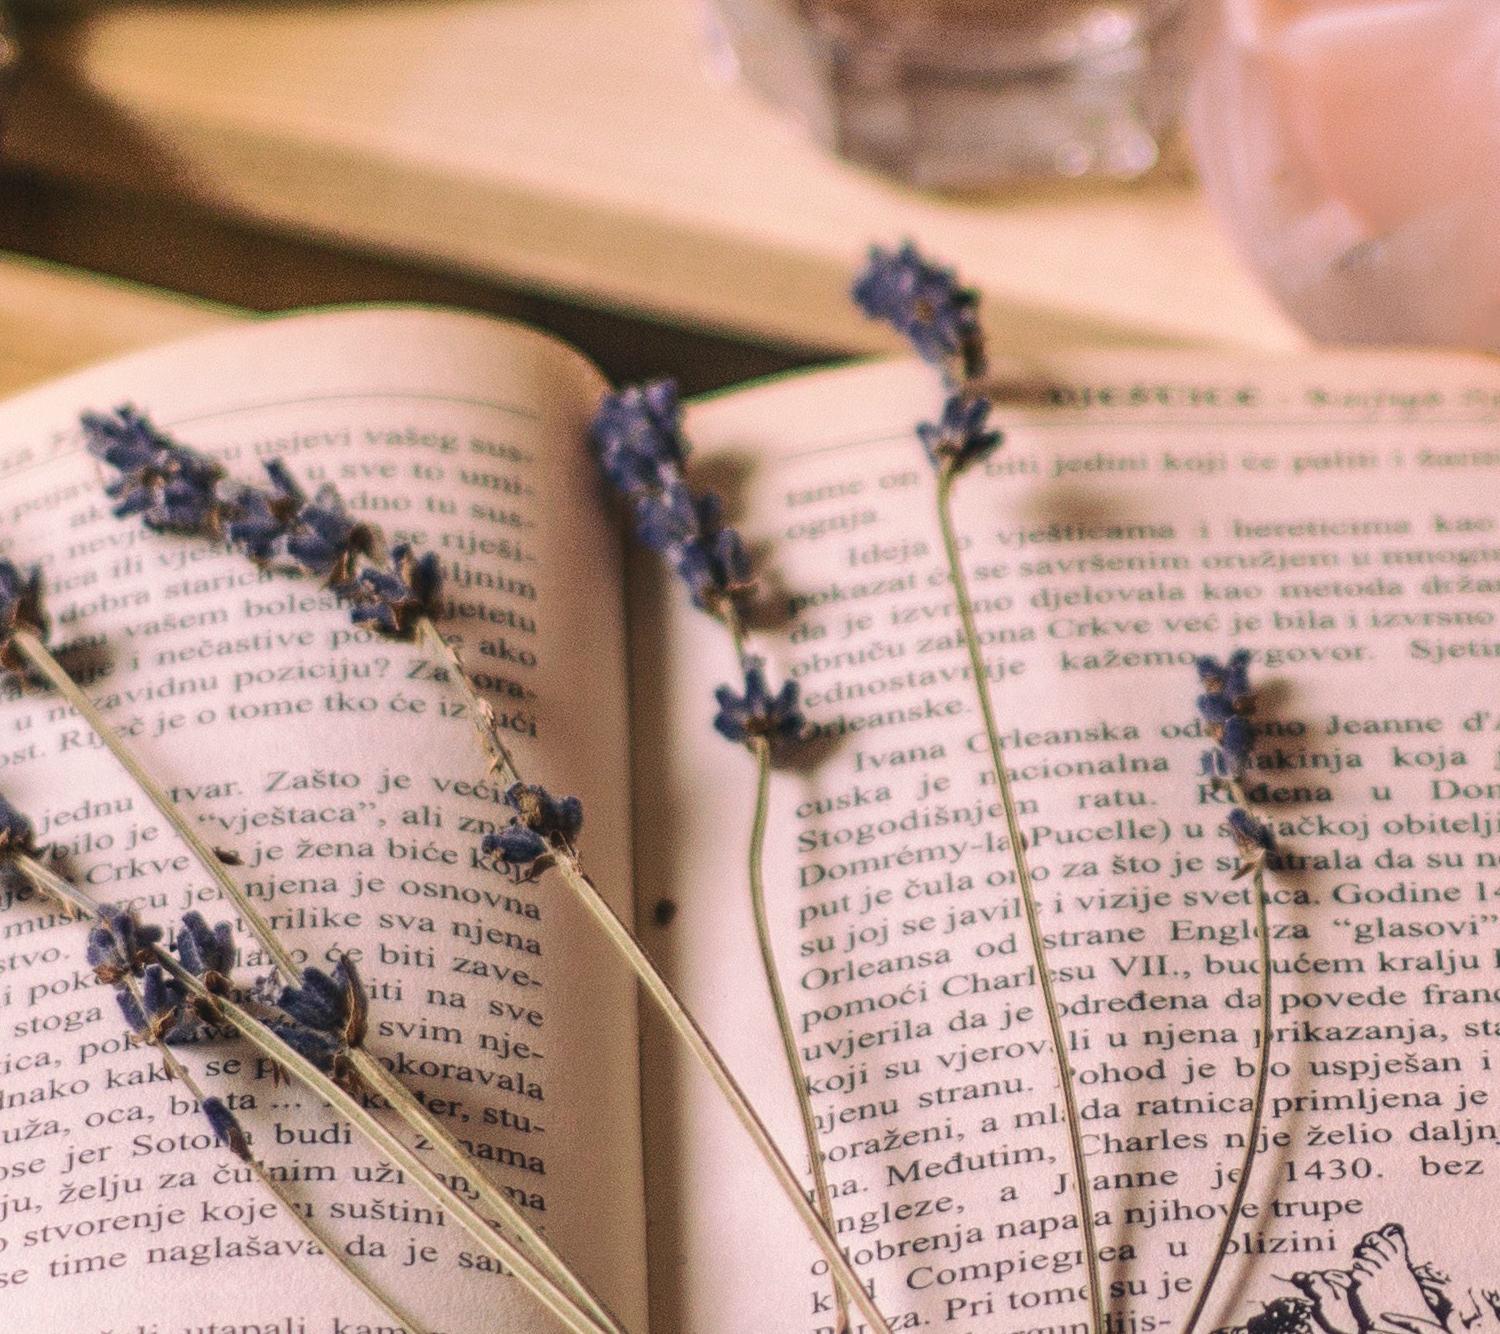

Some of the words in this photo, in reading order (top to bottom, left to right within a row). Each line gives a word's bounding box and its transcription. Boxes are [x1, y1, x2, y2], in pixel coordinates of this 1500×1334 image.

[1047, 614, 1150, 641] Crkve
[854, 741, 946, 773] Ivana
[1325, 714, 1442, 737] Jeanne
[265, 769, 362, 793] Zašto
[796, 783, 891, 820] cuska
[1394, 744, 1467, 770] koja
[1078, 787, 1156, 811] ratu.
[400, 875, 542, 921] osnovna
[904, 869, 973, 903] čula
[1112, 852, 1161, 874] što
[1075, 885, 1172, 915] vizije
[1333, 880, 1461, 906] Godine
[801, 945, 952, 992] Orleansa
[1043, 921, 1145, 950] strane
[802, 983, 929, 1035] pomoći
[1379, 948, 1480, 978] kralju
[803, 1017, 933, 1063] uvjerila
[1144, 1021, 1239, 1052] njena
[918, 1076, 1033, 1109] stranu.
[1309, 1051, 1462, 1081] uspješan
[1273, 1083, 1442, 1120] primljena
[887, 1144, 1057, 1189] Međutim,
[1308, 1123, 1392, 1148] želio
[1285, 1157, 1384, 1183] 1430.
[1421, 1155, 1483, 1177] bez
[59, 1175, 143, 1206] želju
[1271, 1195, 1364, 1223] trupe
[22, 1205, 186, 1249] stvorenje
[201, 1198, 278, 1227] koje
[946, 1294, 996, 1323] Pri
